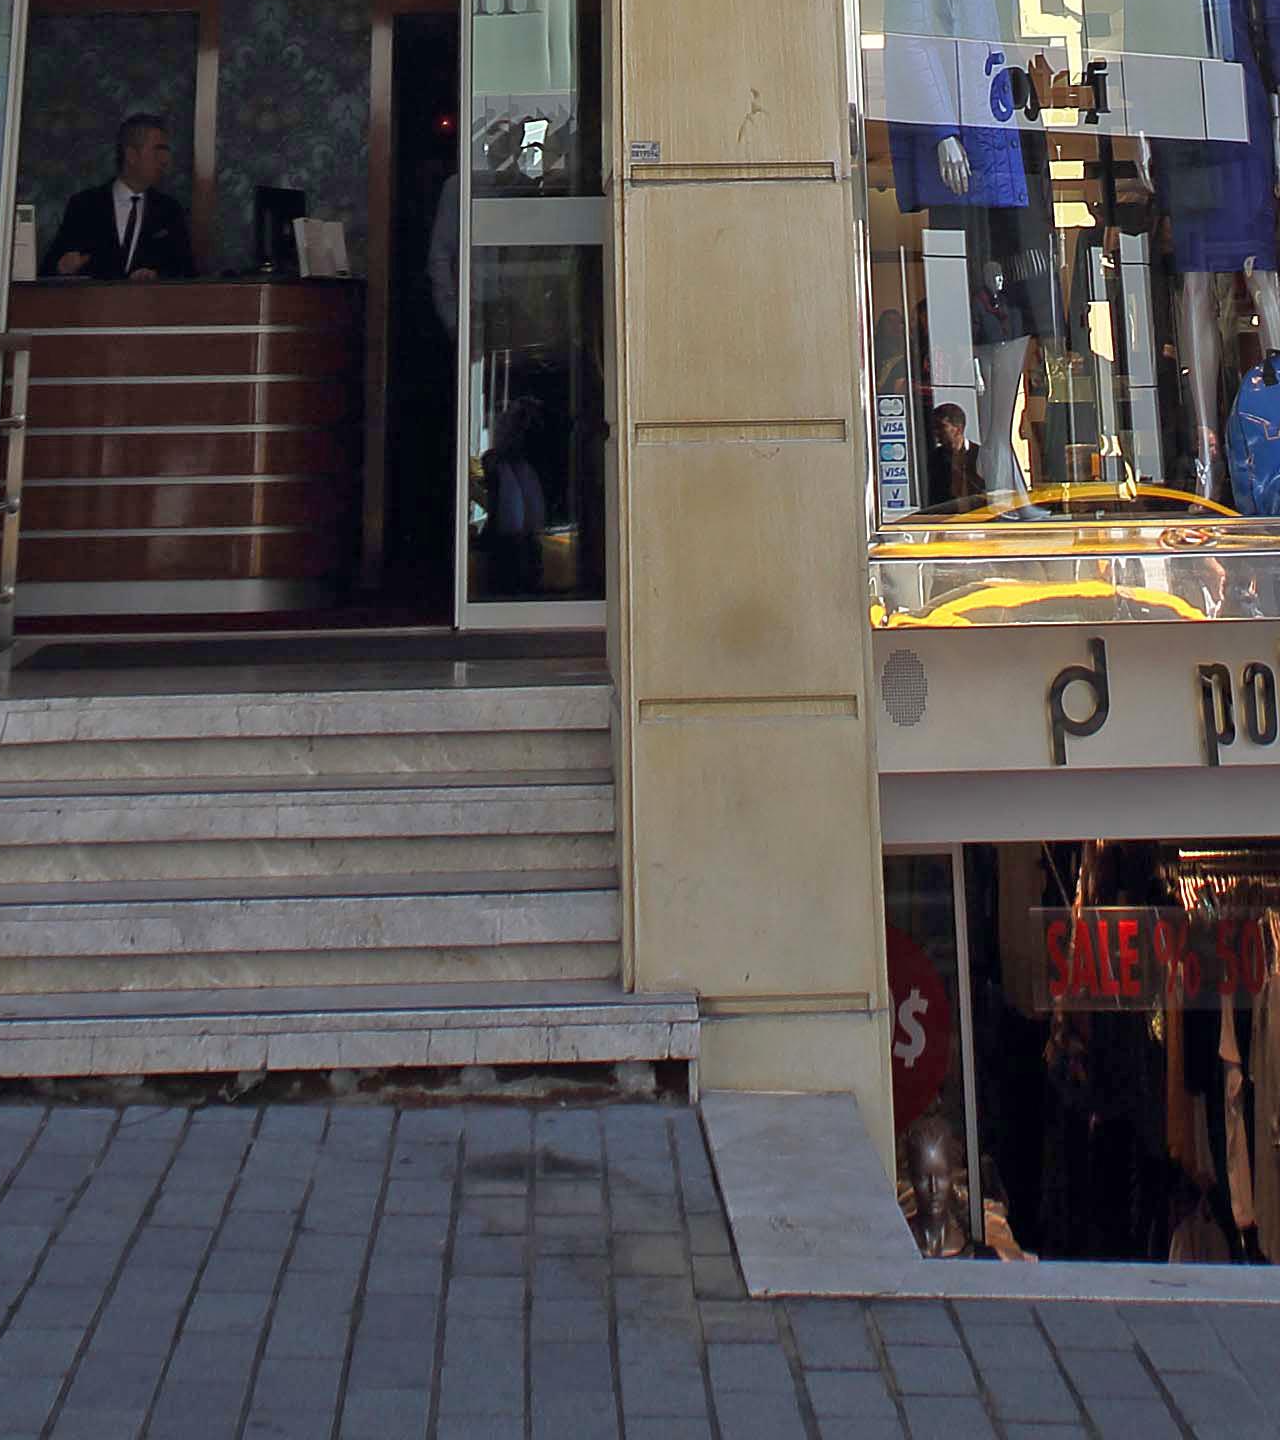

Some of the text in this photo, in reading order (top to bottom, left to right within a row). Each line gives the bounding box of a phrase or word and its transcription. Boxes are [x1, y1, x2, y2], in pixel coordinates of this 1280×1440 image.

[882, 422, 905, 433] VISA
[884, 467, 907, 478] VISA
[1045, 918, 1141, 998] SALE
